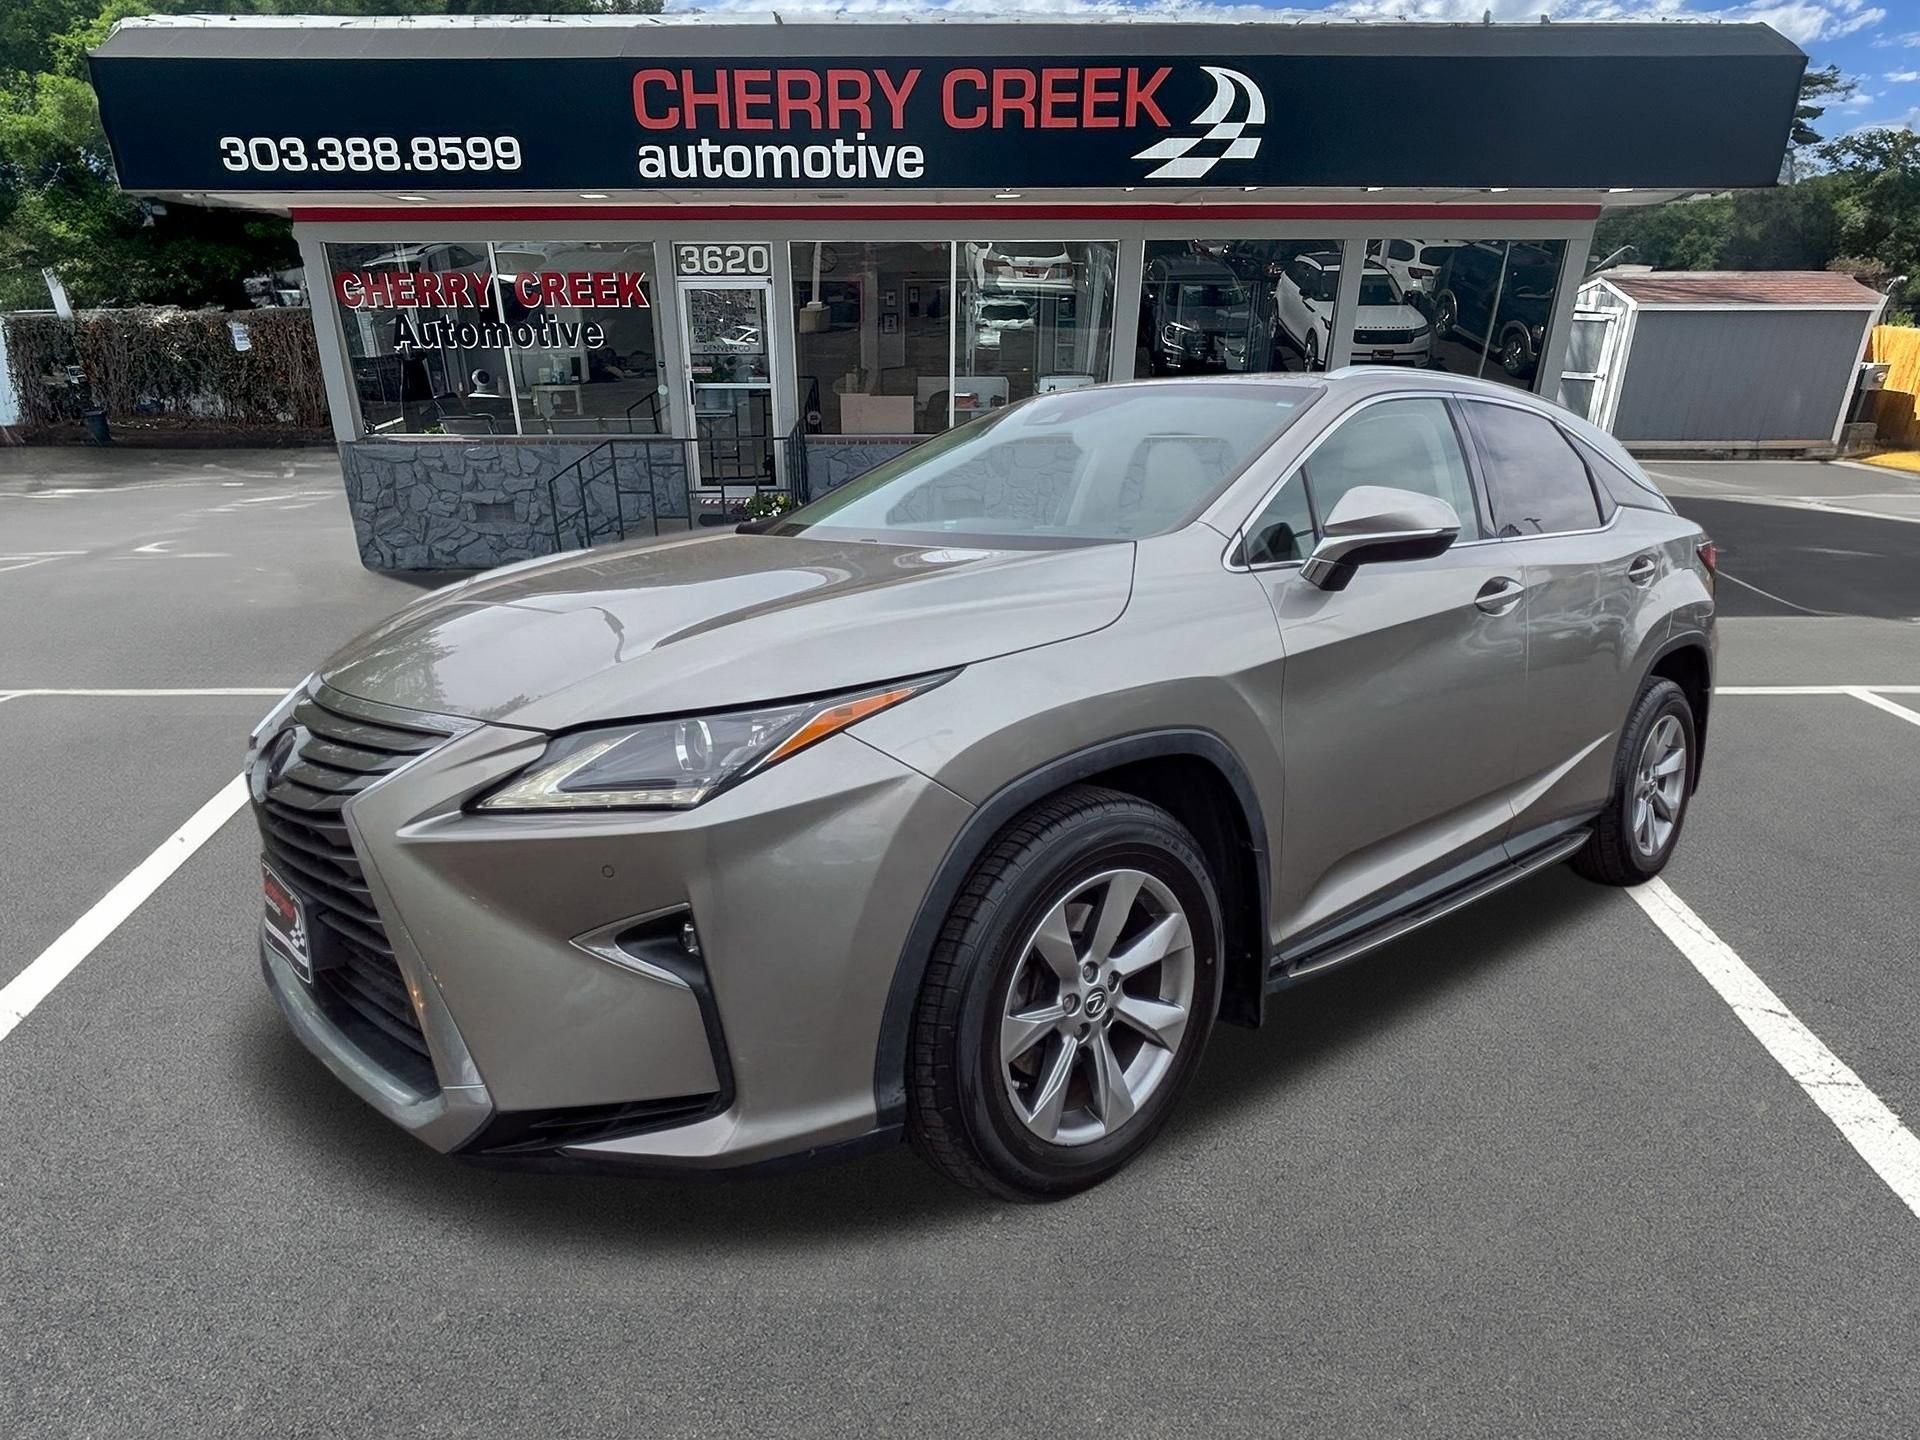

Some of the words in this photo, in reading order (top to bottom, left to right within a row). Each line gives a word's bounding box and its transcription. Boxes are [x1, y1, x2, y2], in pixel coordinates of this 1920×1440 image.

[632, 67, 921, 131] CHERRY
[941, 66, 1172, 129] CREEK
[219, 135, 523, 173] 303.388.8599
[638, 131, 925, 180] automotive
[681, 246, 768, 273] 3620
[334, 271, 493, 309] CHERRY
[514, 271, 650, 308] CREEK
[393, 313, 606, 350] Automotive
